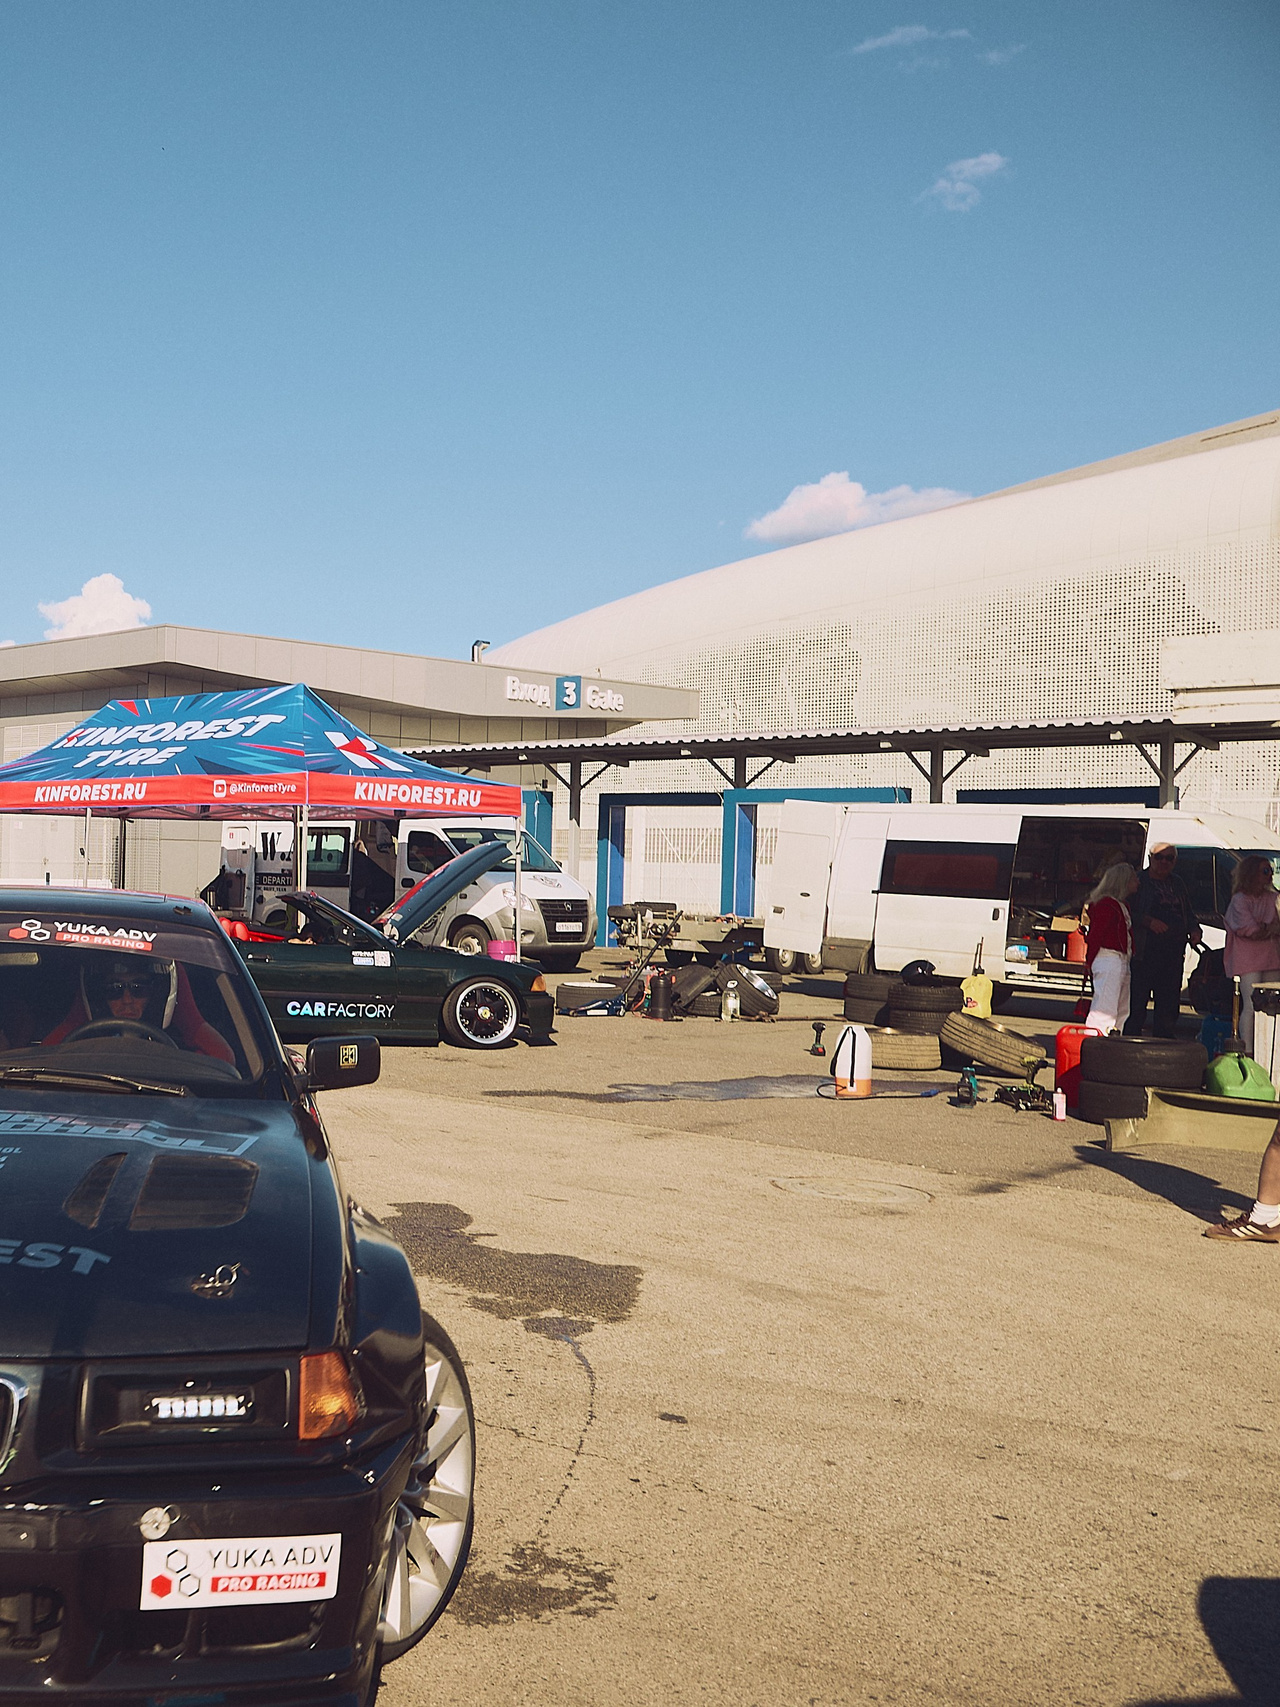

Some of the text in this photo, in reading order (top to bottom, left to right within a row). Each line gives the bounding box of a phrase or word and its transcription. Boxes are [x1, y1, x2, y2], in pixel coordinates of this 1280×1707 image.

[506, 676, 624, 711] Вход 3 Gate
[52, 713, 287, 750] KINFOREST
[72, 746, 187, 769] TYRE
[34, 782, 147, 802] KINFOREST.RU
[229, 783, 297, 795] @KinforestTyre
[354, 782, 482, 807] KINFOREST.RU
[54, 921, 158, 942] YUKA ADV
[63, 933, 145, 949] PRO RACING
[208, 1545, 335, 1569] YUKA ADV
[218, 1573, 320, 1592] PRO RACING
